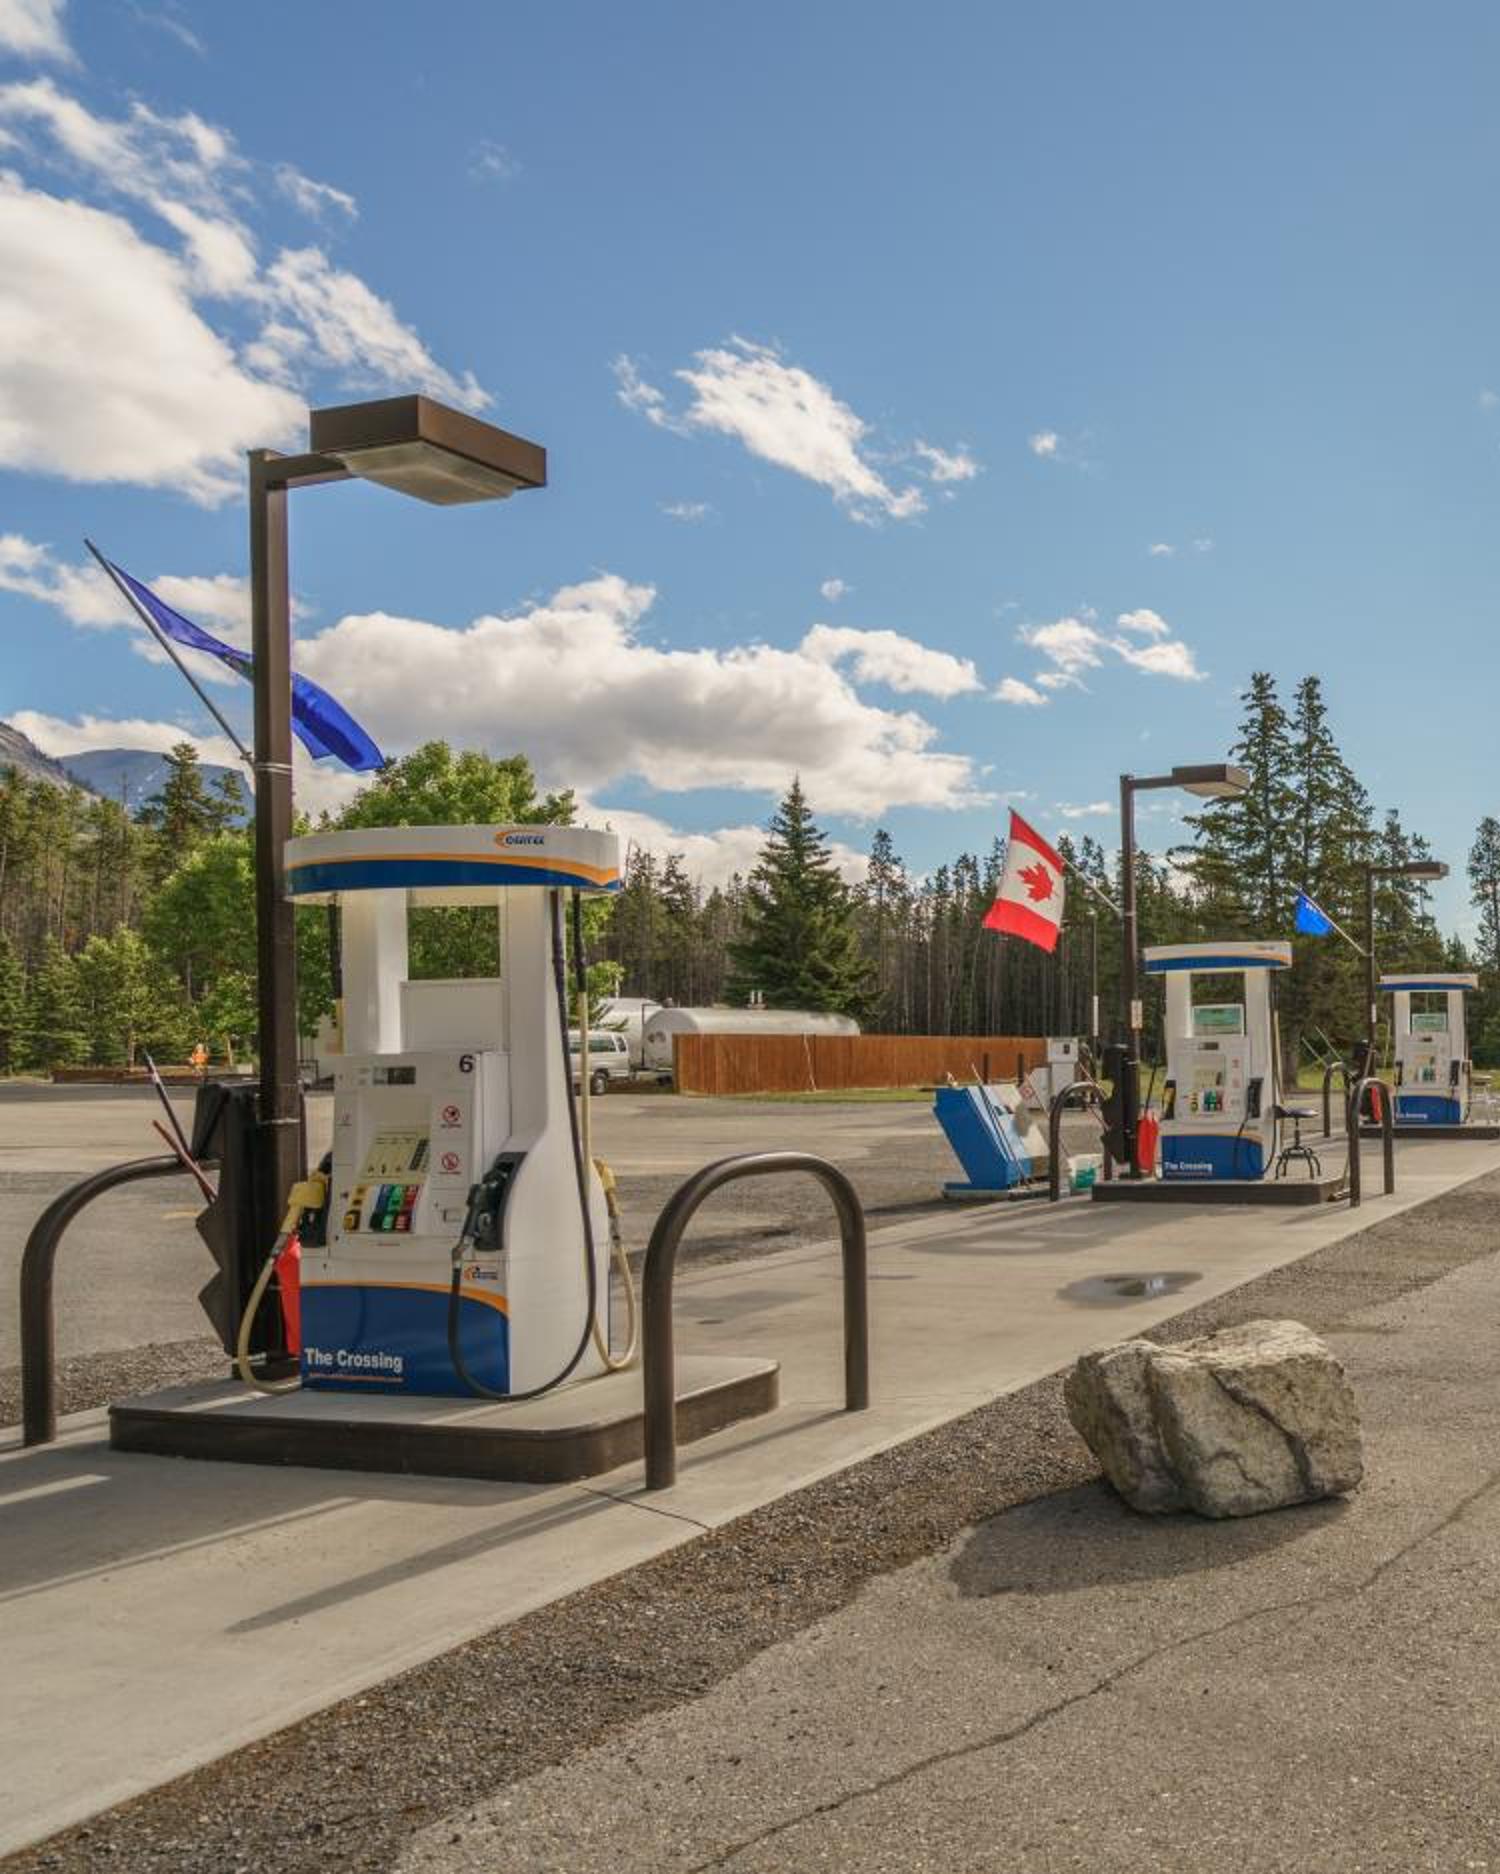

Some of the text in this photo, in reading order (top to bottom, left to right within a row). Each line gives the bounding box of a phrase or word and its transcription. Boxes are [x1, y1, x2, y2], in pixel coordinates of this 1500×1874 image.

[458, 1054, 475, 1074] 6
[305, 1347, 403, 1372] The Crossing
